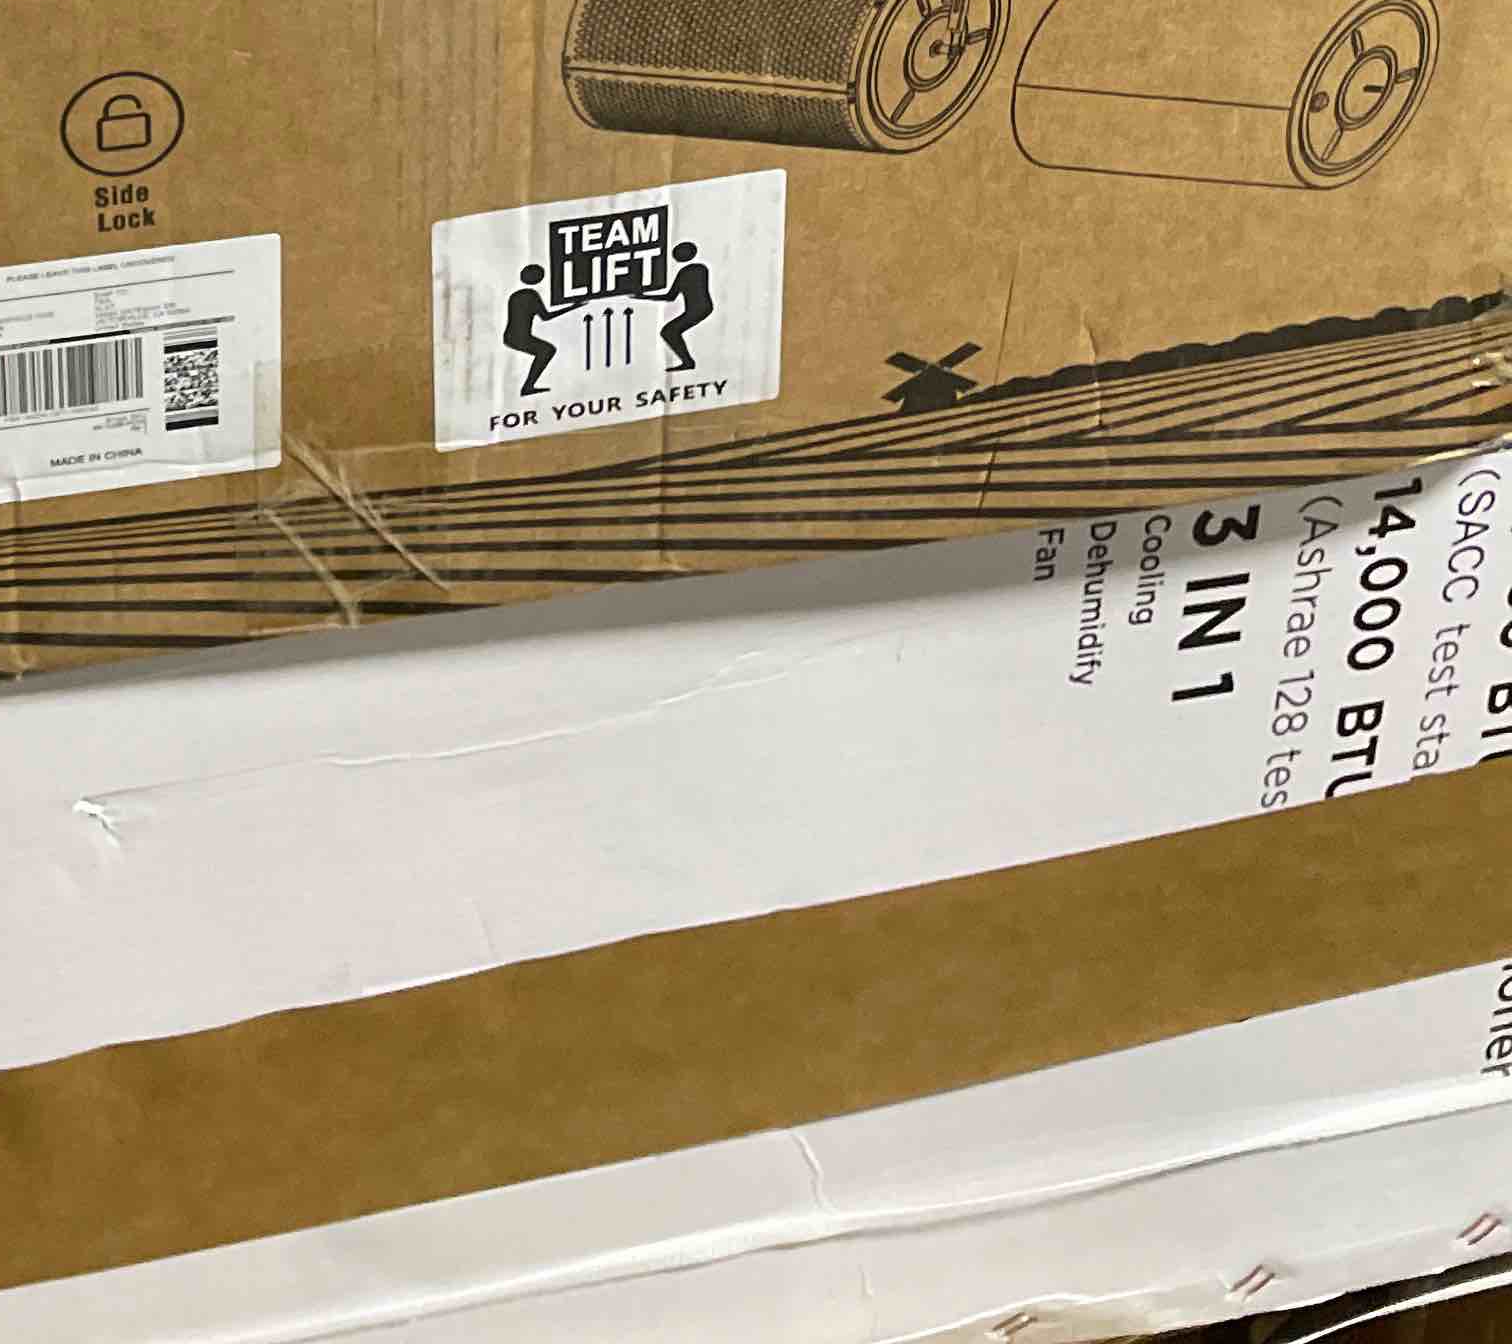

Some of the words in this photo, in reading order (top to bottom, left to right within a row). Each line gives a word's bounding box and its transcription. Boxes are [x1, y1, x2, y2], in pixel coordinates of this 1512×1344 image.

[94, 183, 150, 209] Side
[97, 206, 157, 234] Lock
[557, 213, 660, 255] TEAM
[563, 248, 662, 298] LIFT
[489, 409, 539, 431] FOR
[551, 397, 622, 421] YOUR
[635, 378, 729, 408] SAFETY
[49, 454, 86, 468] MADE
[104, 447, 144, 461] CHINA
[1033, 527, 1065, 582] Fan
[1192, 503, 1262, 548] 3
[1441, 468, 1500, 603] (SACC
[1127, 514, 1173, 625] Cooling
[1282, 495, 1344, 659] (Ashrae
[1346, 477, 1423, 671] 14,000
[1068, 520, 1118, 686] Dehumidify
[1177, 571, 1251, 651] IN
[1170, 671, 1235, 702] 1
[1424, 623, 1471, 701] test
[1271, 669, 1315, 737] 128
[1411, 713, 1451, 771] sta
[1260, 749, 1302, 809] tes
